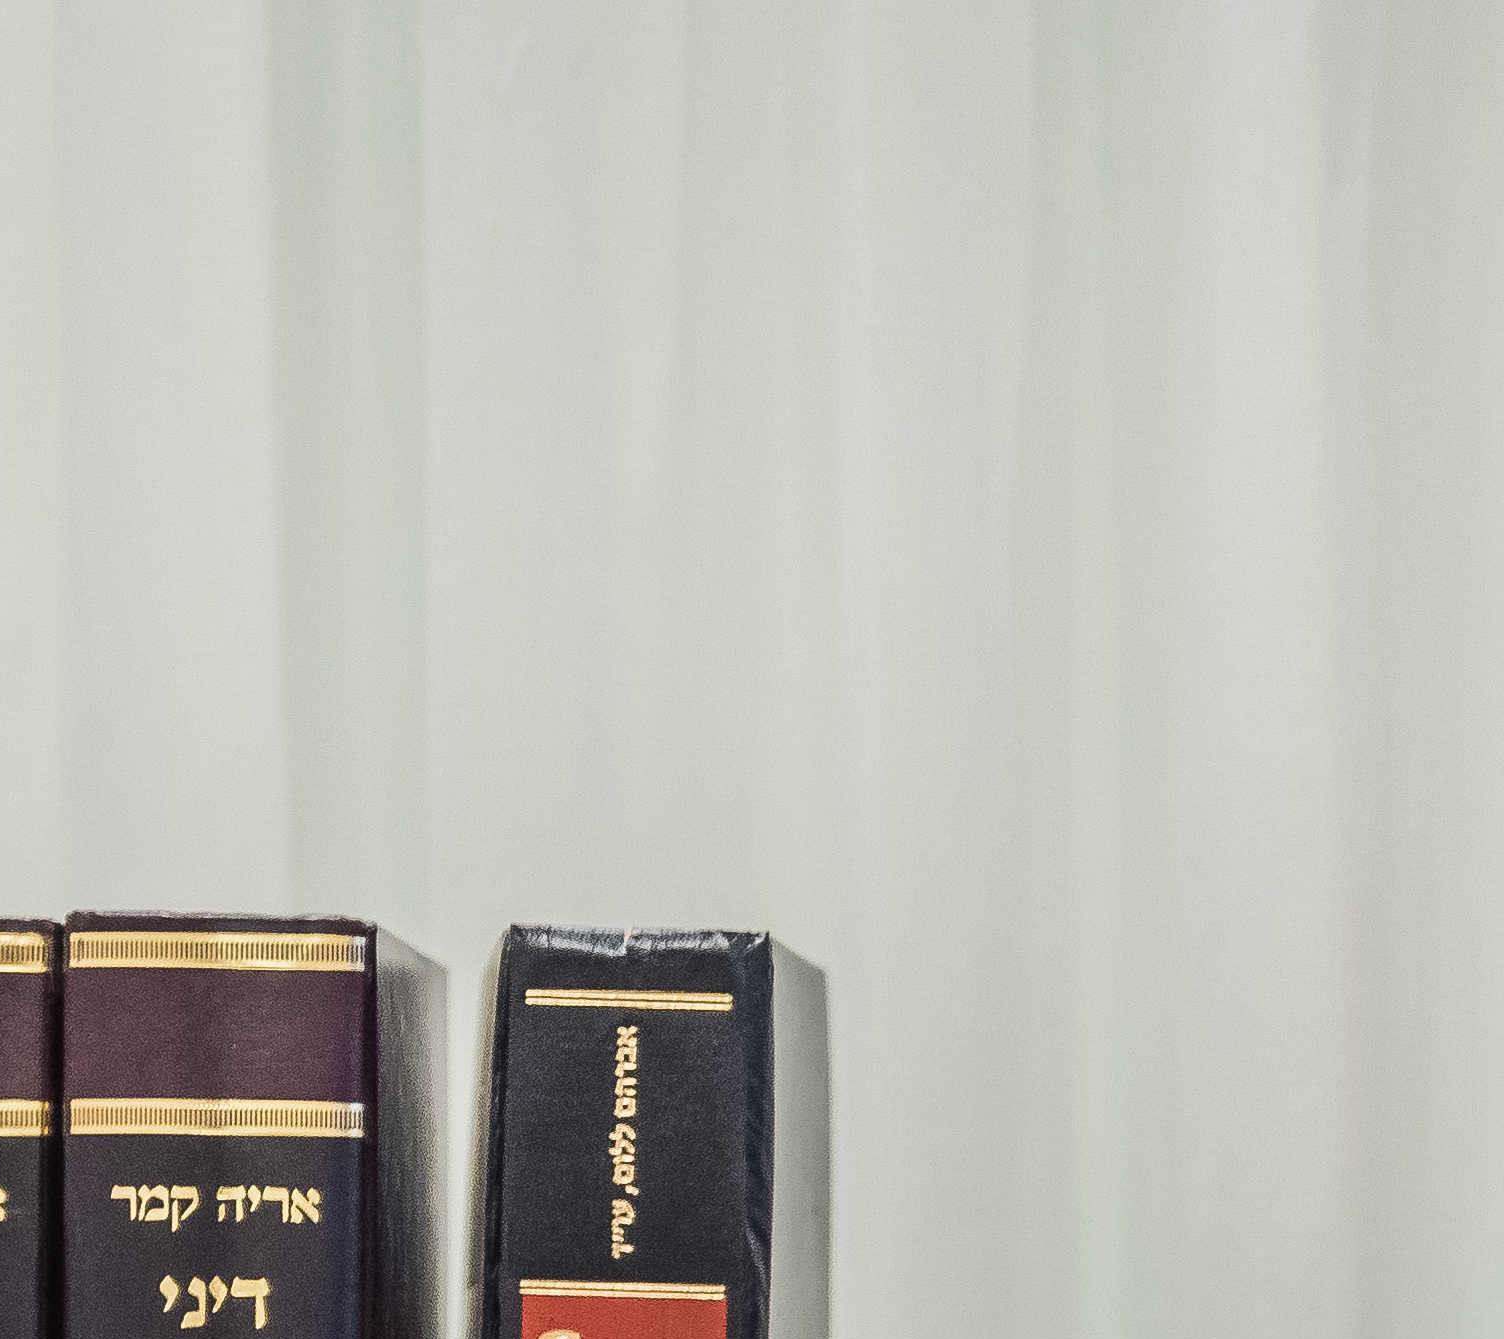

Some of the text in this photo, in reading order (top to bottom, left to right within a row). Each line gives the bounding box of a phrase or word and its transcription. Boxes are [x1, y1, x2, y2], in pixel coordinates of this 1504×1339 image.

[110, 1184, 322, 1233] אריה קמר
[159, 1273, 271, 1330] דיני
